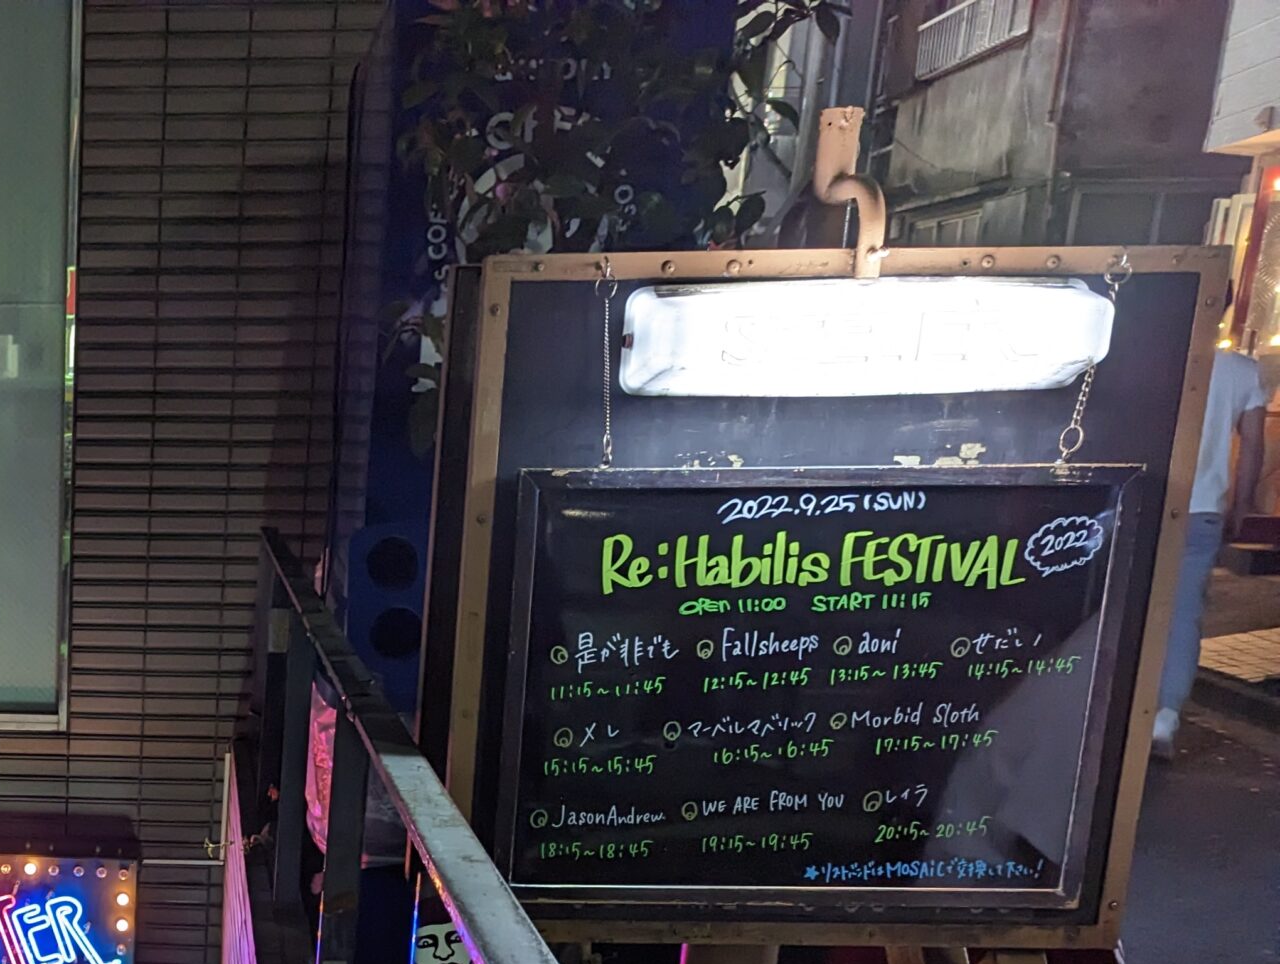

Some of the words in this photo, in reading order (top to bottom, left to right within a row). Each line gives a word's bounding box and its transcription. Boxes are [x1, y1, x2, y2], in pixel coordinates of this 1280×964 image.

[1040, 530, 1089, 557] 2022
[602, 531, 830, 595] Re:Habilis
[839, 530, 1026, 590] FESTIVAL
[739, 597, 787, 613] 11:00
[811, 592, 875, 613] START
[882, 592, 932, 610] 11:15
[574, 632, 679, 673] 是が非でも
[722, 628, 819, 662] Fallsheeps
[851, 701, 924, 728] Morbid
[933, 702, 980, 728] Sloth
[702, 800, 727, 817] WE
[732, 796, 760, 815] ARE
[769, 789, 808, 811] FROM
[818, 792, 845, 809] YOU
[885, 783, 928, 807] レイラ
